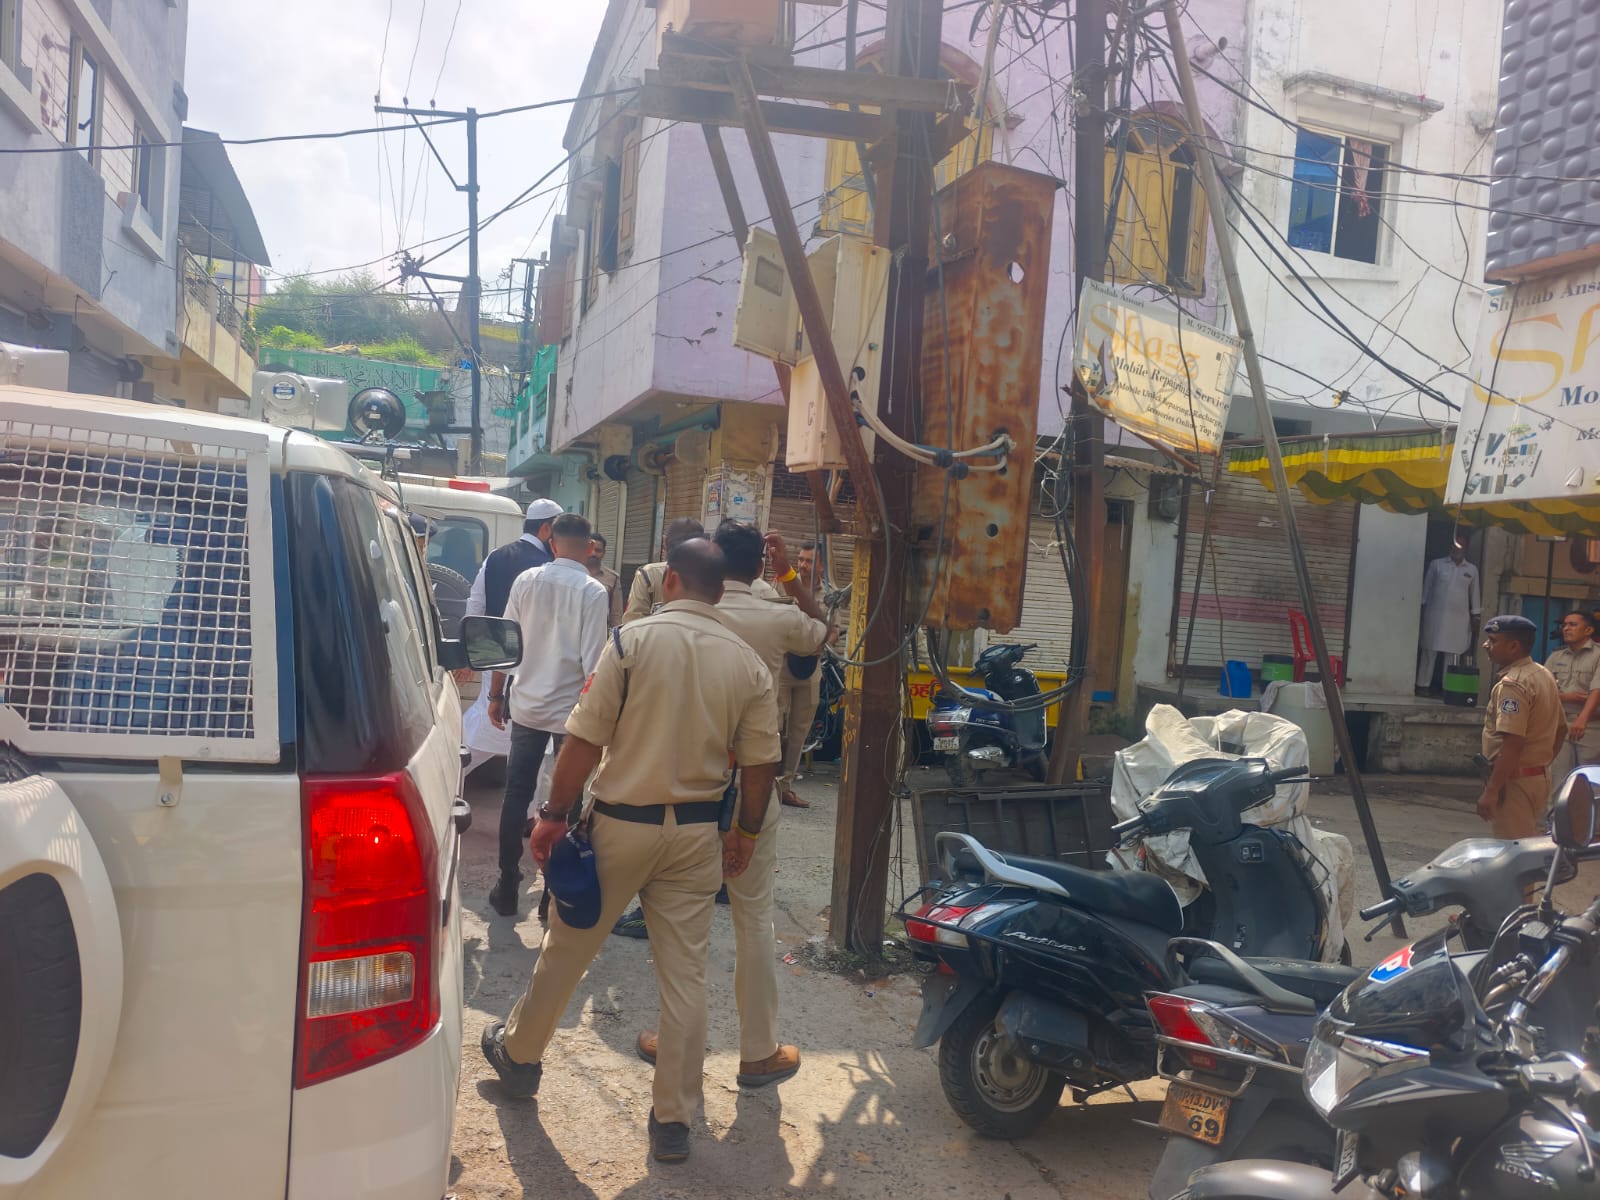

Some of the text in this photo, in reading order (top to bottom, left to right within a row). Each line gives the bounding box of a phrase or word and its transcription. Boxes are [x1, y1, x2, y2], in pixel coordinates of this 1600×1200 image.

[1115, 356, 1149, 377] Mobile
[1195, 388, 1230, 410] Service
[1188, 1114, 1220, 1138] 69
